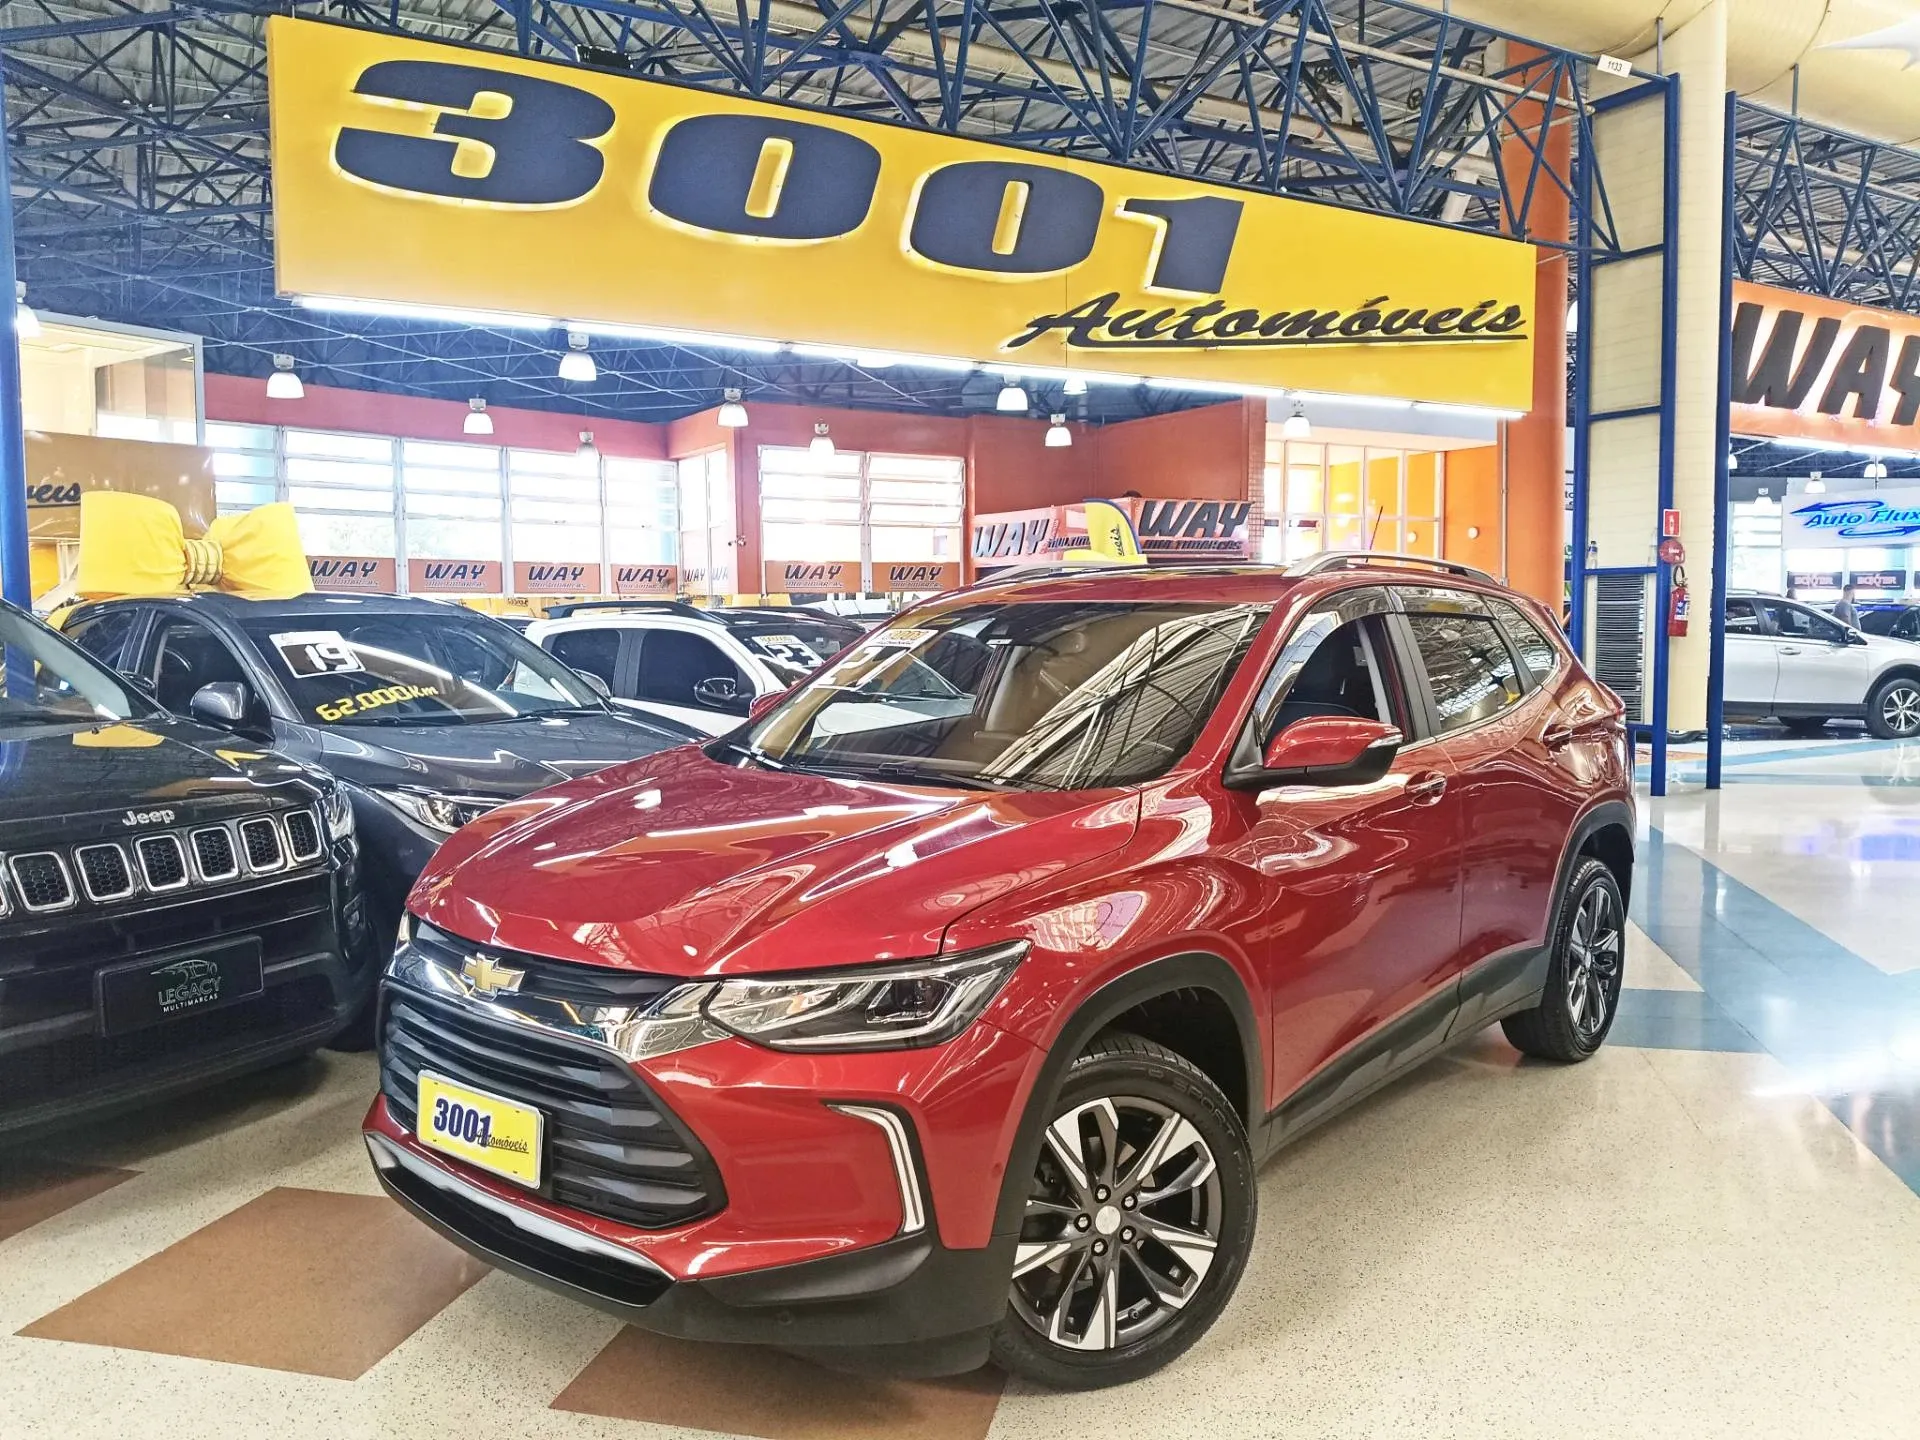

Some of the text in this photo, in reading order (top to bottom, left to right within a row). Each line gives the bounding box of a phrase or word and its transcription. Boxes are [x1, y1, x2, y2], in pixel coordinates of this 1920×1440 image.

[1608, 61, 1622, 71] 1133
[335, 60, 1244, 295] 3001
[1001, 291, 1528, 348] Automóveis
[1139, 500, 1252, 537] WAY
[1804, 512, 1862, 526] Auto
[973, 519, 1050, 557] WAY
[310, 560, 378, 578] WAY
[425, 563, 486, 579] WAY
[528, 566, 585, 581] WAY
[617, 568, 669, 582] WAY
[682, 569, 706, 582] WAY
[785, 564, 842, 579] WAY
[889, 566, 942, 581] WAY
[304, 642, 360, 672] 19
[768, 644, 824, 669] 23
[122, 809, 175, 826] Jeep
[158, 976, 222, 1006] LEGACY
[163, 993, 218, 1013] MULTIMARCAS
[434, 1098, 492, 1148] 3001
